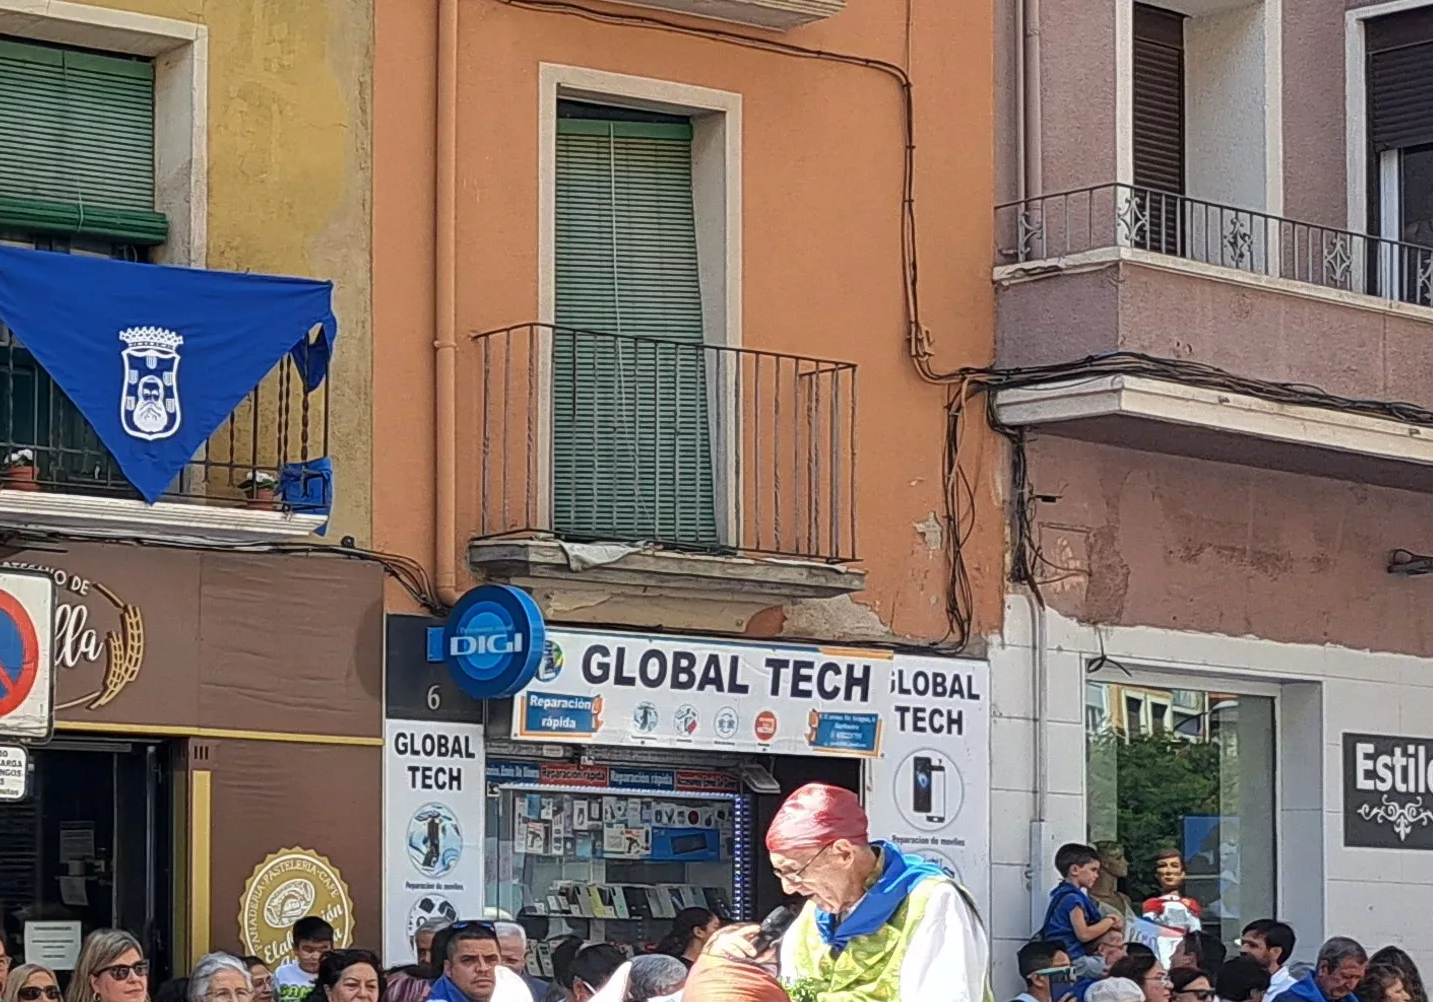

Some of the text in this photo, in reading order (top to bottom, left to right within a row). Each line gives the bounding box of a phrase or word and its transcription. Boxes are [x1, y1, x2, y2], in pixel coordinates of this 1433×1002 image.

[450, 633, 522, 656] DIGI
[582, 645, 871, 702] GLOBAL TECH
[890, 669, 980, 700] LOBAL
[427, 684, 441, 710] 6
[529, 694, 592, 710] Reparación
[541, 714, 576, 729] rápida
[895, 705, 963, 736] TECH
[394, 731, 476, 759] GLOBAL
[407, 765, 462, 791] TECH
